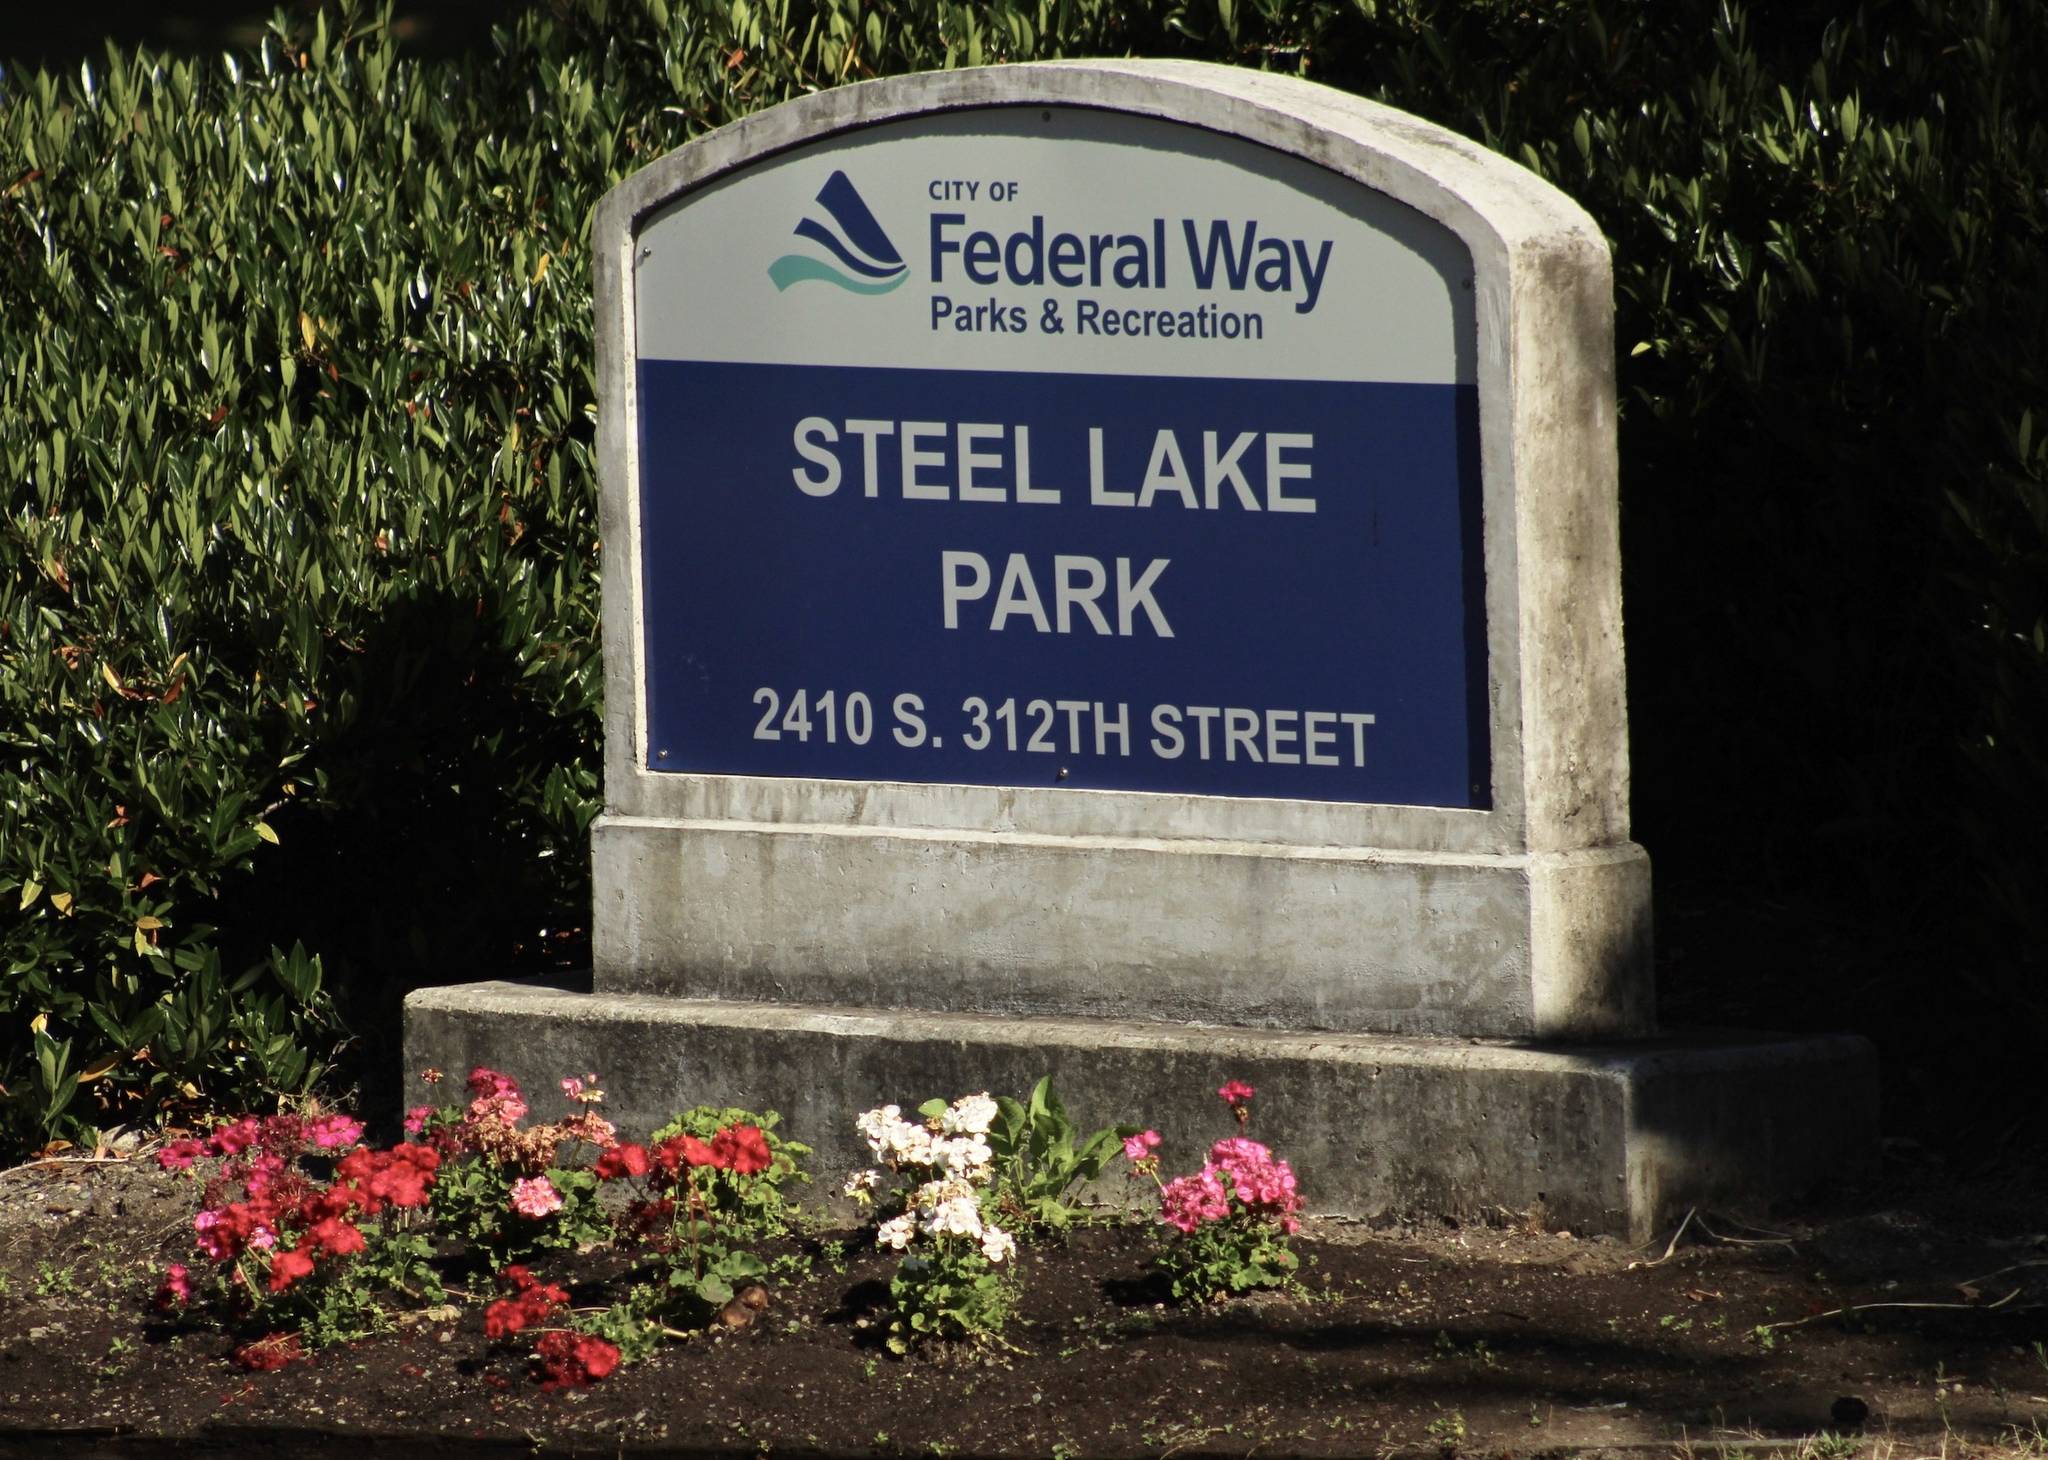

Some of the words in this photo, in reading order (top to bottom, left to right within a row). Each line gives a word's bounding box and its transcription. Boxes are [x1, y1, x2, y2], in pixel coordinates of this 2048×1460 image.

[928, 180, 980, 201] CITY
[989, 181, 1019, 202] OF
[930, 213, 1166, 289] Federal
[1179, 219, 1334, 315] Way
[931, 295, 1028, 334] Parks
[1039, 298, 1065, 335] &
[1076, 299, 1263, 340] Recreation
[792, 416, 1061, 505] STEEL
[1089, 427, 1317, 513] LAKE
[942, 550, 1175, 638] PARK
[753, 687, 873, 746] 2410
[892, 692, 942, 748] S.
[962, 696, 1130, 756] 312TH
[1150, 703, 1376, 768] STREET
